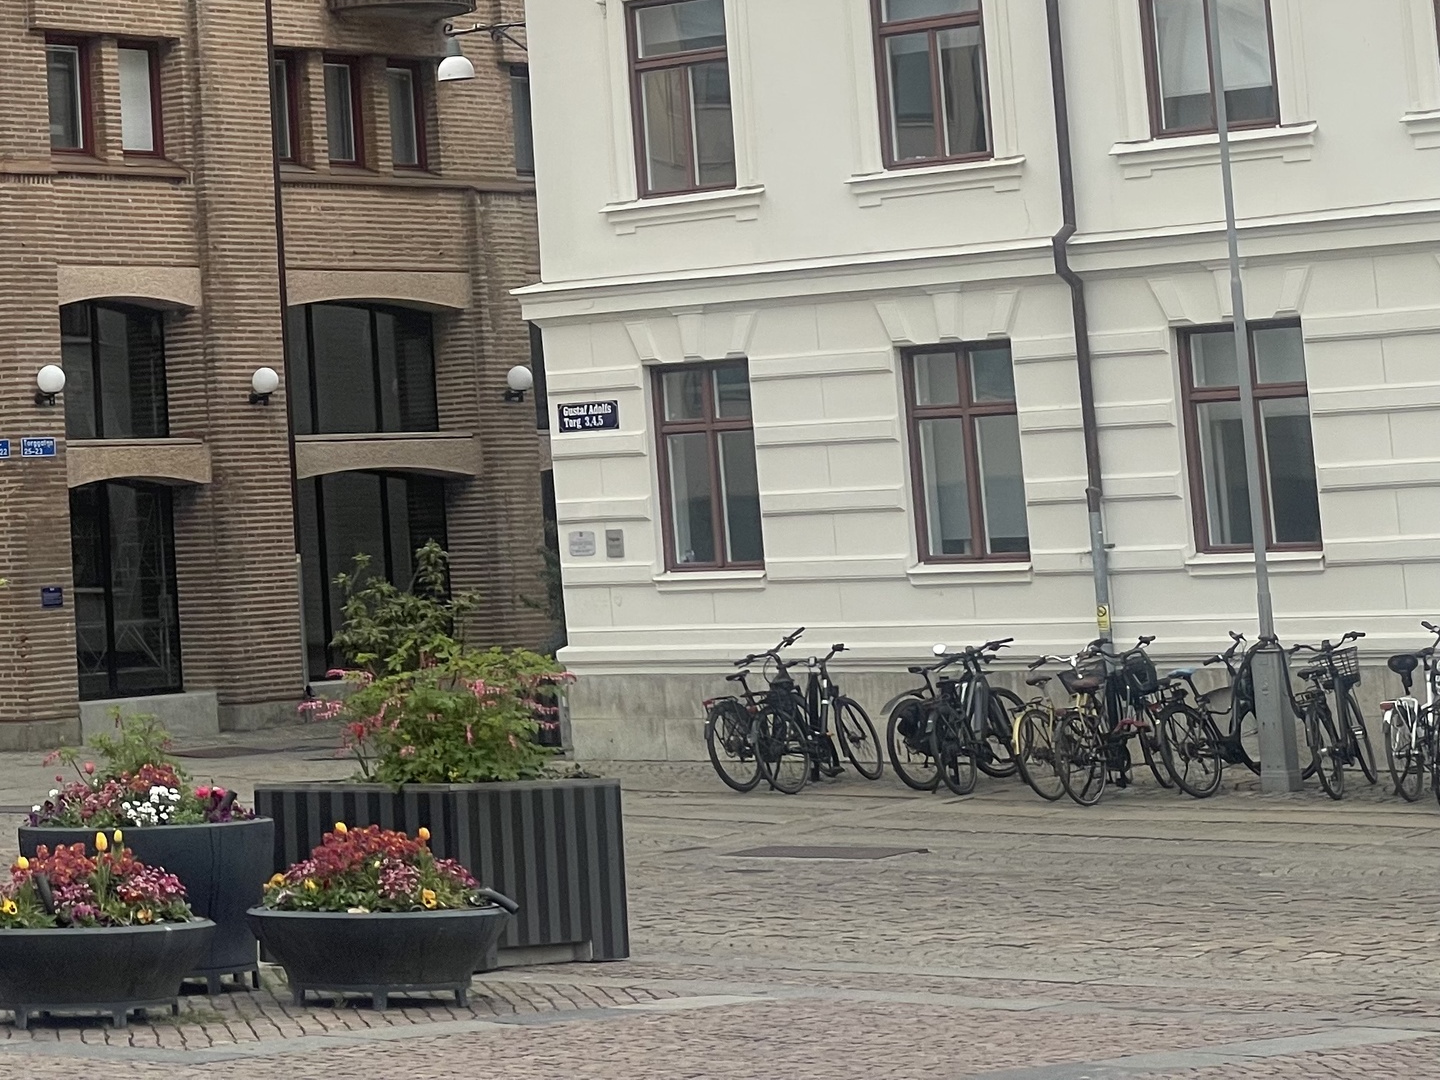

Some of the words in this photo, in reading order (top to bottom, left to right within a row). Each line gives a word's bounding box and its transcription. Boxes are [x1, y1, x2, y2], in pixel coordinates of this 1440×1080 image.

[563, 405, 587, 416] Gustaf
[588, 404, 612, 414] Adolfs
[564, 418, 582, 429] Torg
